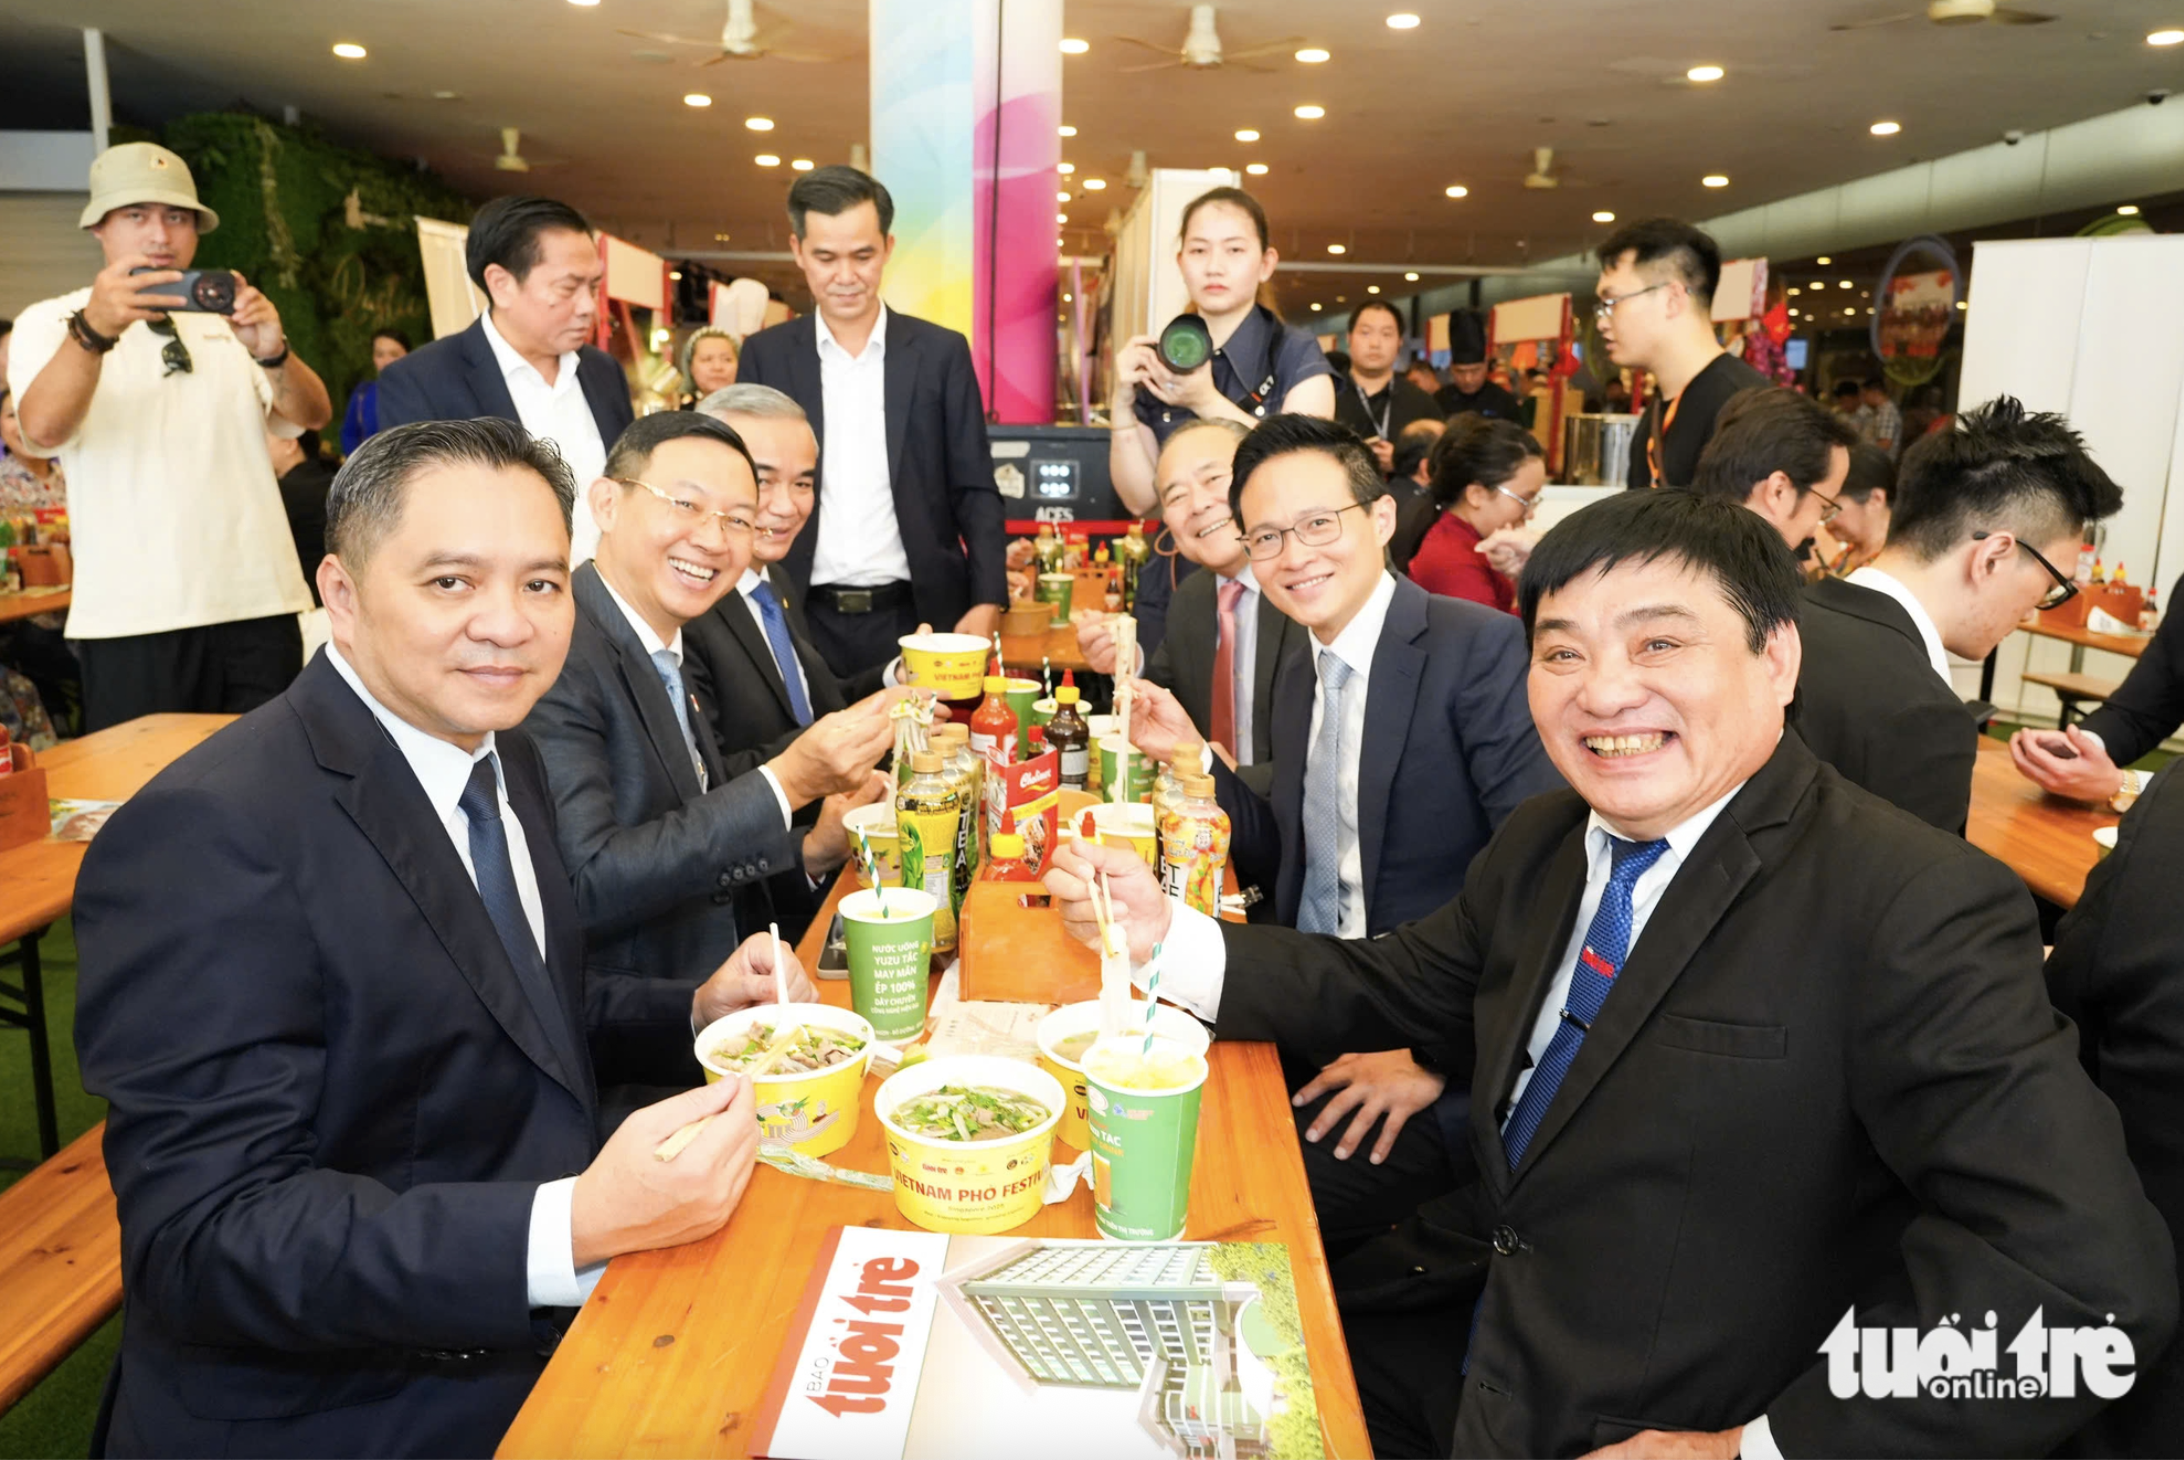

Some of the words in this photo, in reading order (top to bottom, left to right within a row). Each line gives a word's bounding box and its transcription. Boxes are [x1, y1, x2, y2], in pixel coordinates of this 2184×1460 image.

[1035, 506, 1075, 522] ACES
[875, 955, 900, 966] YUZU
[874, 969, 895, 980] MAY
[875, 982, 887, 994] ÉP
[891, 981, 916, 993] 100%
[893, 1166, 953, 1202] VIETNAM
[838, 1256, 920, 1316] trẻ
[805, 1317, 904, 1419] tuổi
